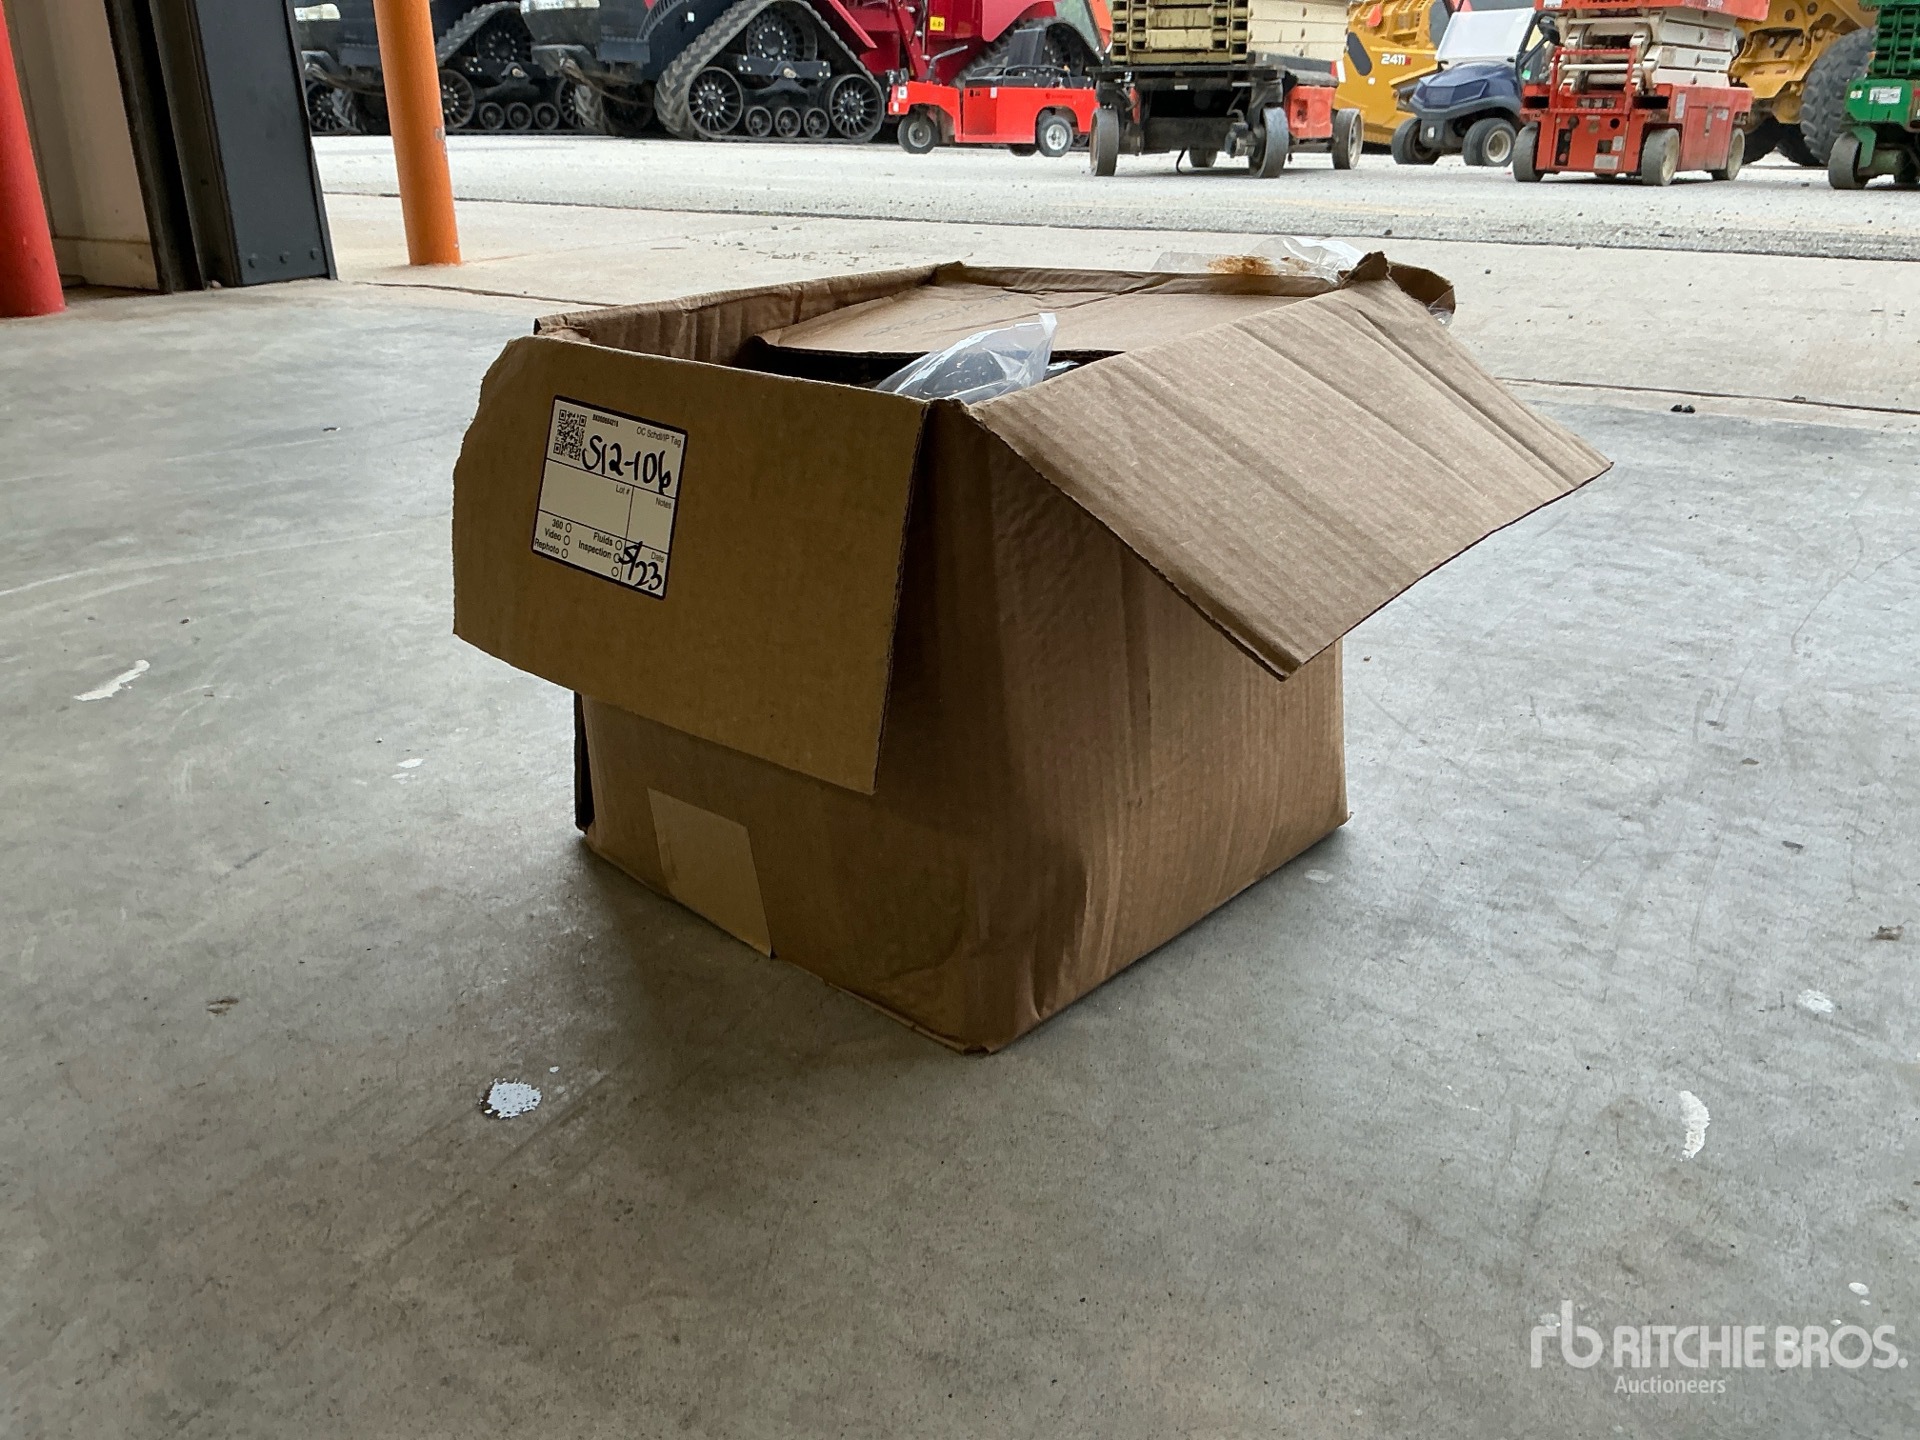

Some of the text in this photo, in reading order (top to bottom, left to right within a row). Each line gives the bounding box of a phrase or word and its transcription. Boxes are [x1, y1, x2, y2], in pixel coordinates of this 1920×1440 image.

[670, 435, 682, 448] Tag
[615, 484, 625, 495] Lot
[655, 497, 672, 510] Notes
[551, 518, 564, 530] 360
[544, 527, 562, 541] Video
[593, 531, 613, 547] Fluids
[534, 537, 560, 555] Rephoto
[578, 539, 612, 560] Inspection
[651, 551, 665, 564] Date
